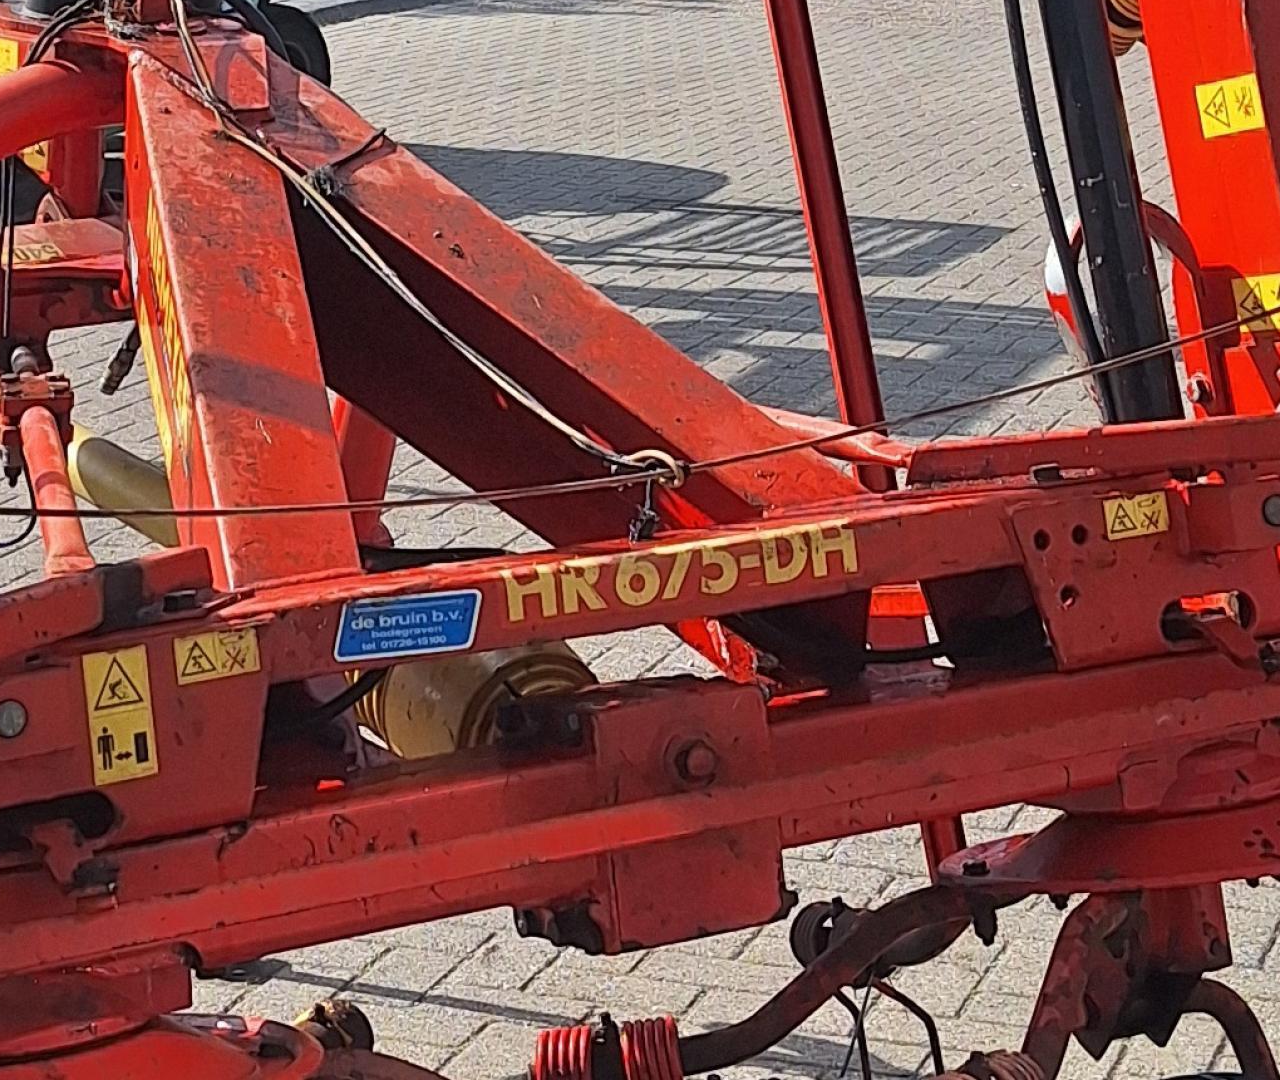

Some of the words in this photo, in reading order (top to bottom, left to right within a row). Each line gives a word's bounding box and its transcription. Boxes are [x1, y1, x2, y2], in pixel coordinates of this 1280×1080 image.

[500, 561, 608, 621] HR
[615, 522, 859, 607] 675-DH
[351, 616, 375, 630] de
[379, 611, 427, 627] bruin
[432, 609, 463, 623] b.v.
